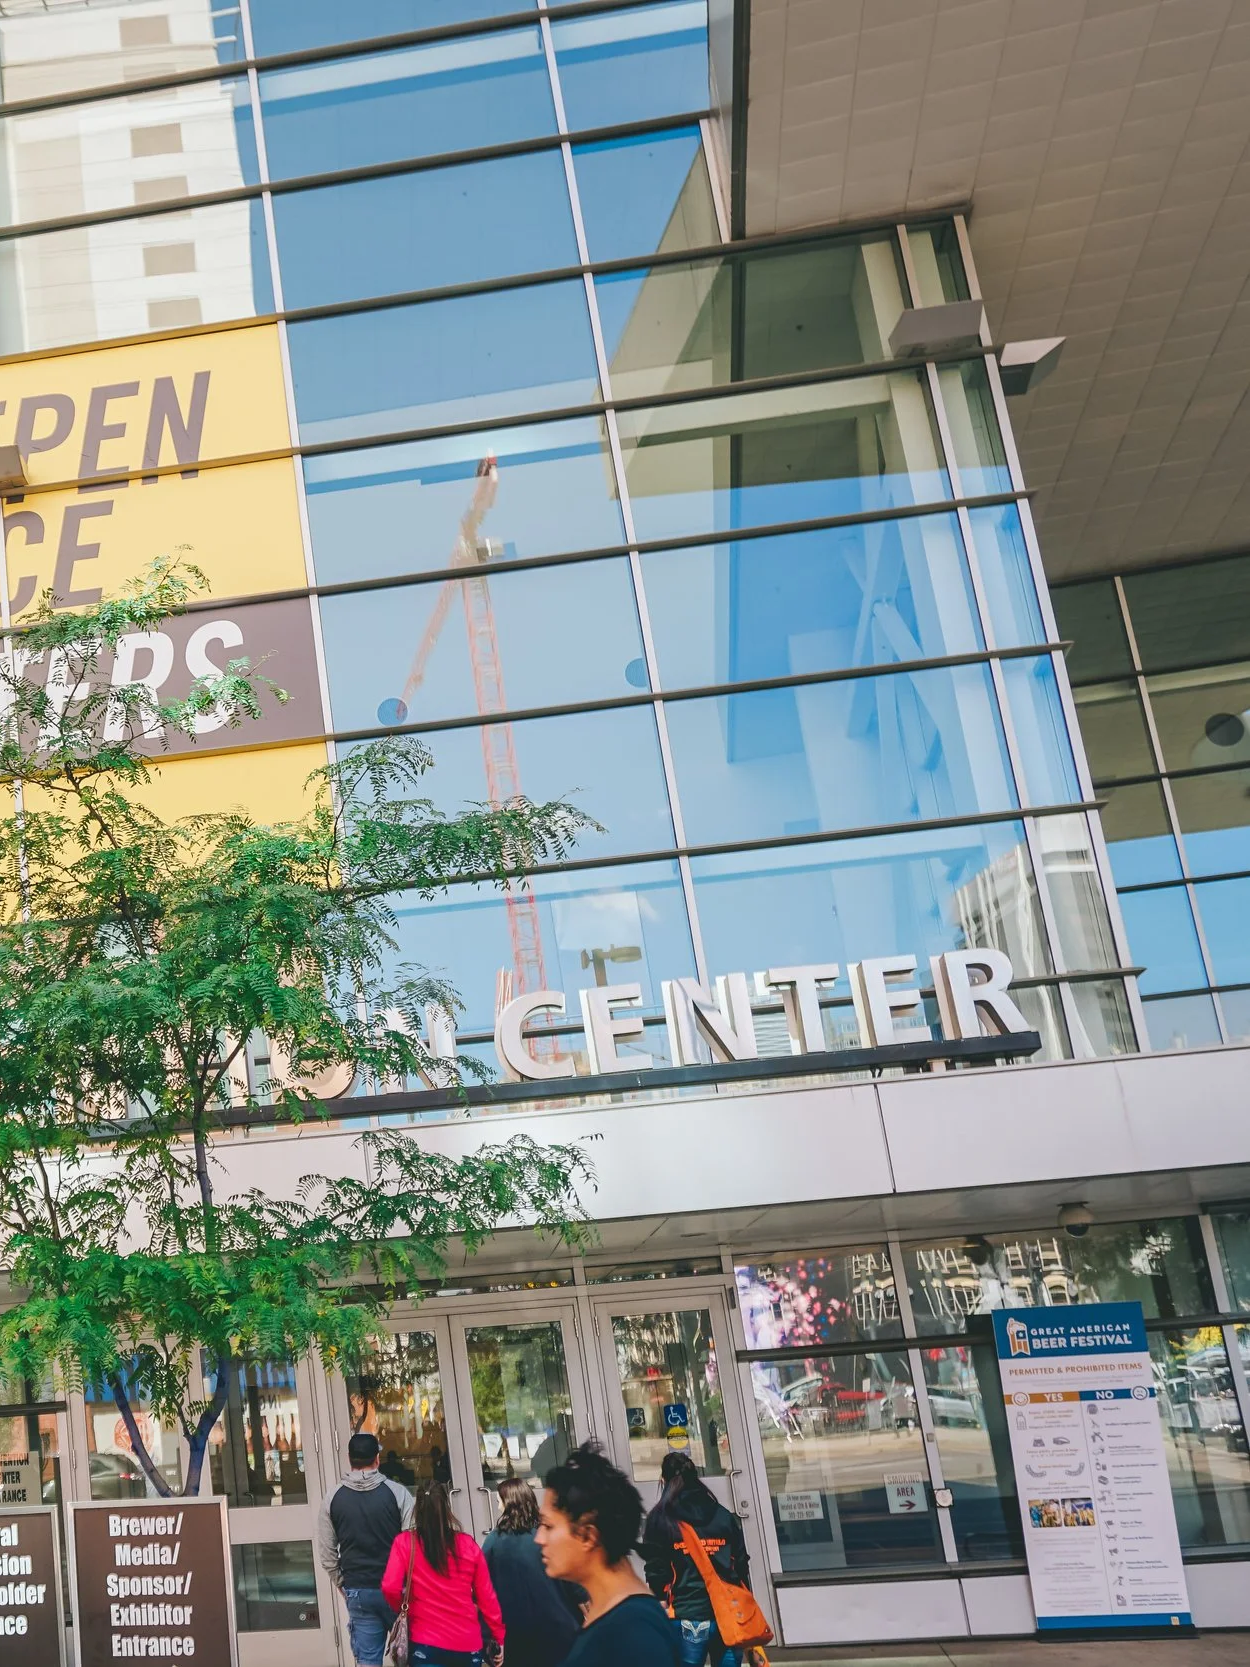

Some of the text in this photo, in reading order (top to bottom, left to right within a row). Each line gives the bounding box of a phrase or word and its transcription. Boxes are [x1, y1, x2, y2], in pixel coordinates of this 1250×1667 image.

[494, 947, 1031, 1082] CENTER
[1030, 1322, 1131, 1336] GREAT AMERICAN
[1031, 1334, 1133, 1350] BEER FESTIVAL
[1008, 1362, 1143, 1377] PERMITTED & PROHIBITED ITEMS
[1043, 1392, 1064, 1403] YES
[1095, 1390, 1115, 1400] NO
[896, 1486, 916, 1497] AREA
[108, 1511, 184, 1538] Brewer/
[114, 1540, 182, 1566] Media/
[106, 1571, 193, 1599] Sponsor/
[110, 1602, 193, 1627] Exhibitor
[111, 1633, 196, 1657] Entrance
